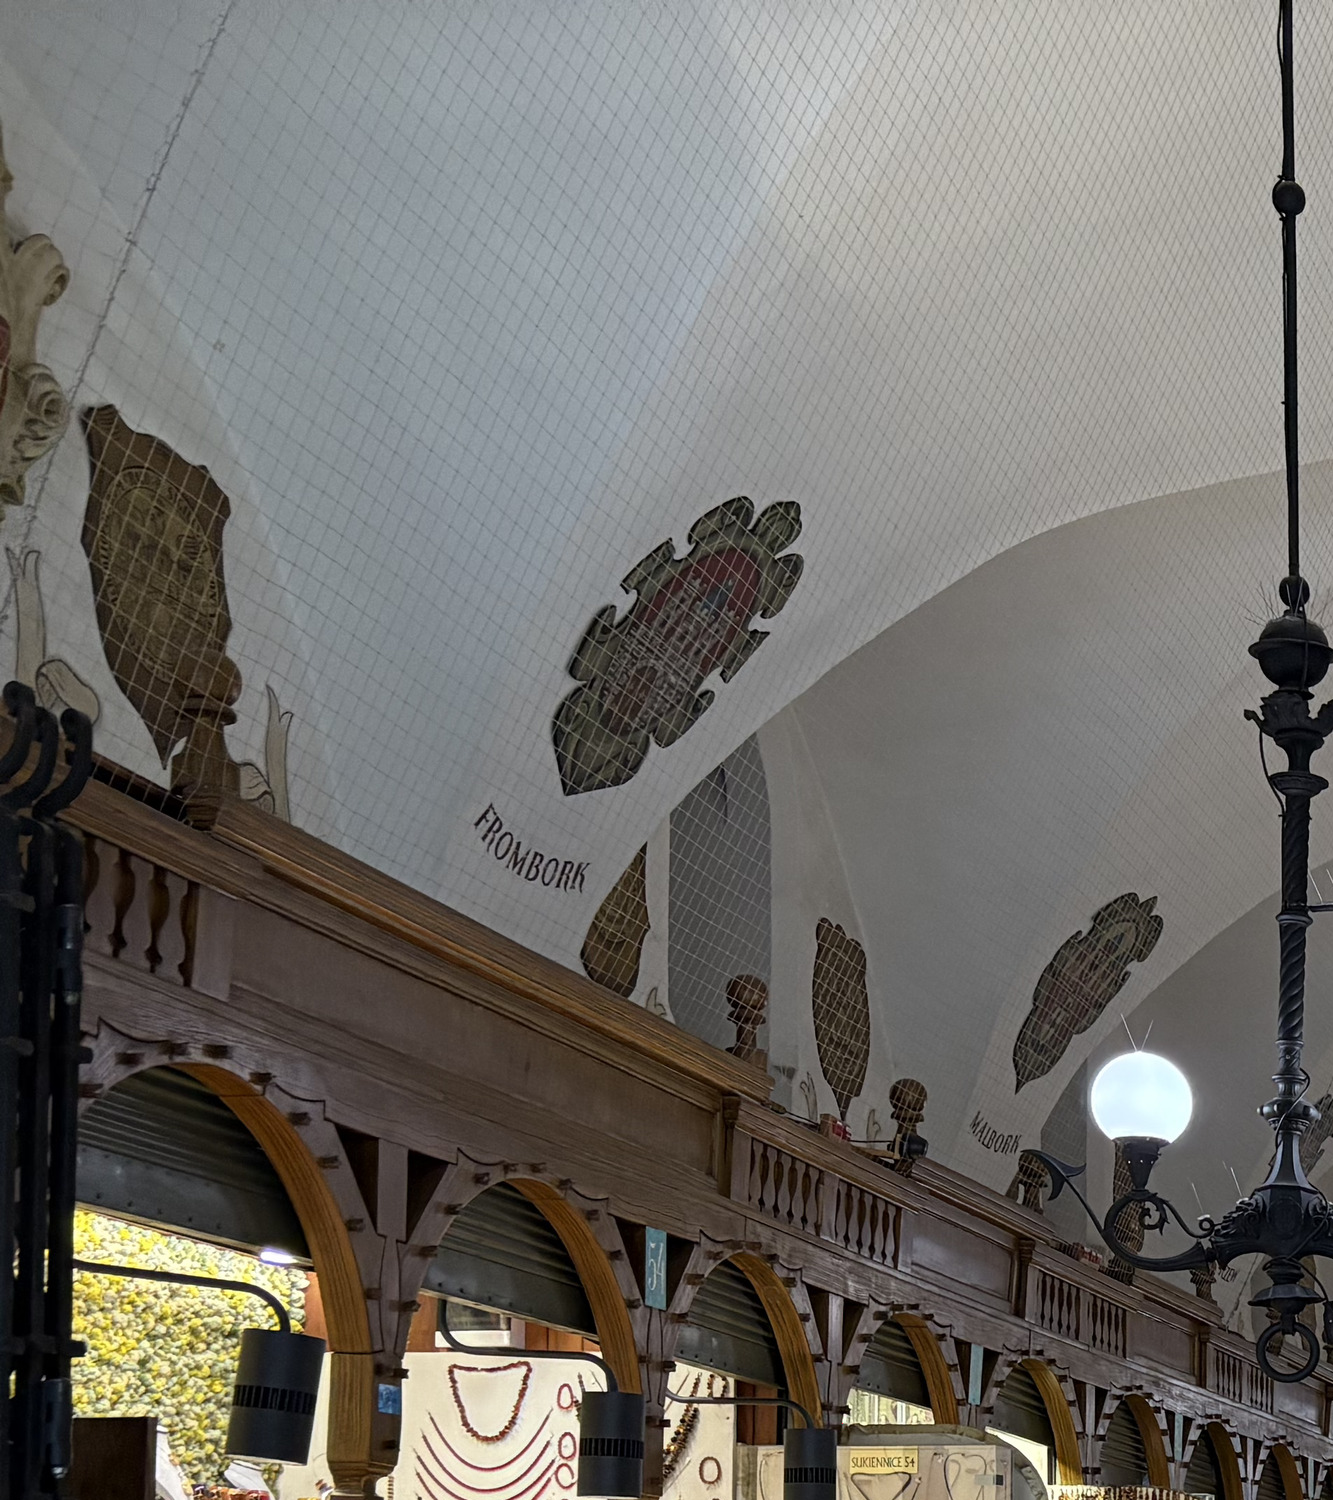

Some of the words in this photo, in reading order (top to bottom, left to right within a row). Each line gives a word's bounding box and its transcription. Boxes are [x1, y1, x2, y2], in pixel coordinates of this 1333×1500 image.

[474, 802, 591, 894] FROMBORK
[970, 1110, 1022, 1155] MALBORK
[648, 1242, 665, 1295] 54
[851, 1456, 903, 1469] SUKIENNICE
[904, 1456, 916, 1468] 54
